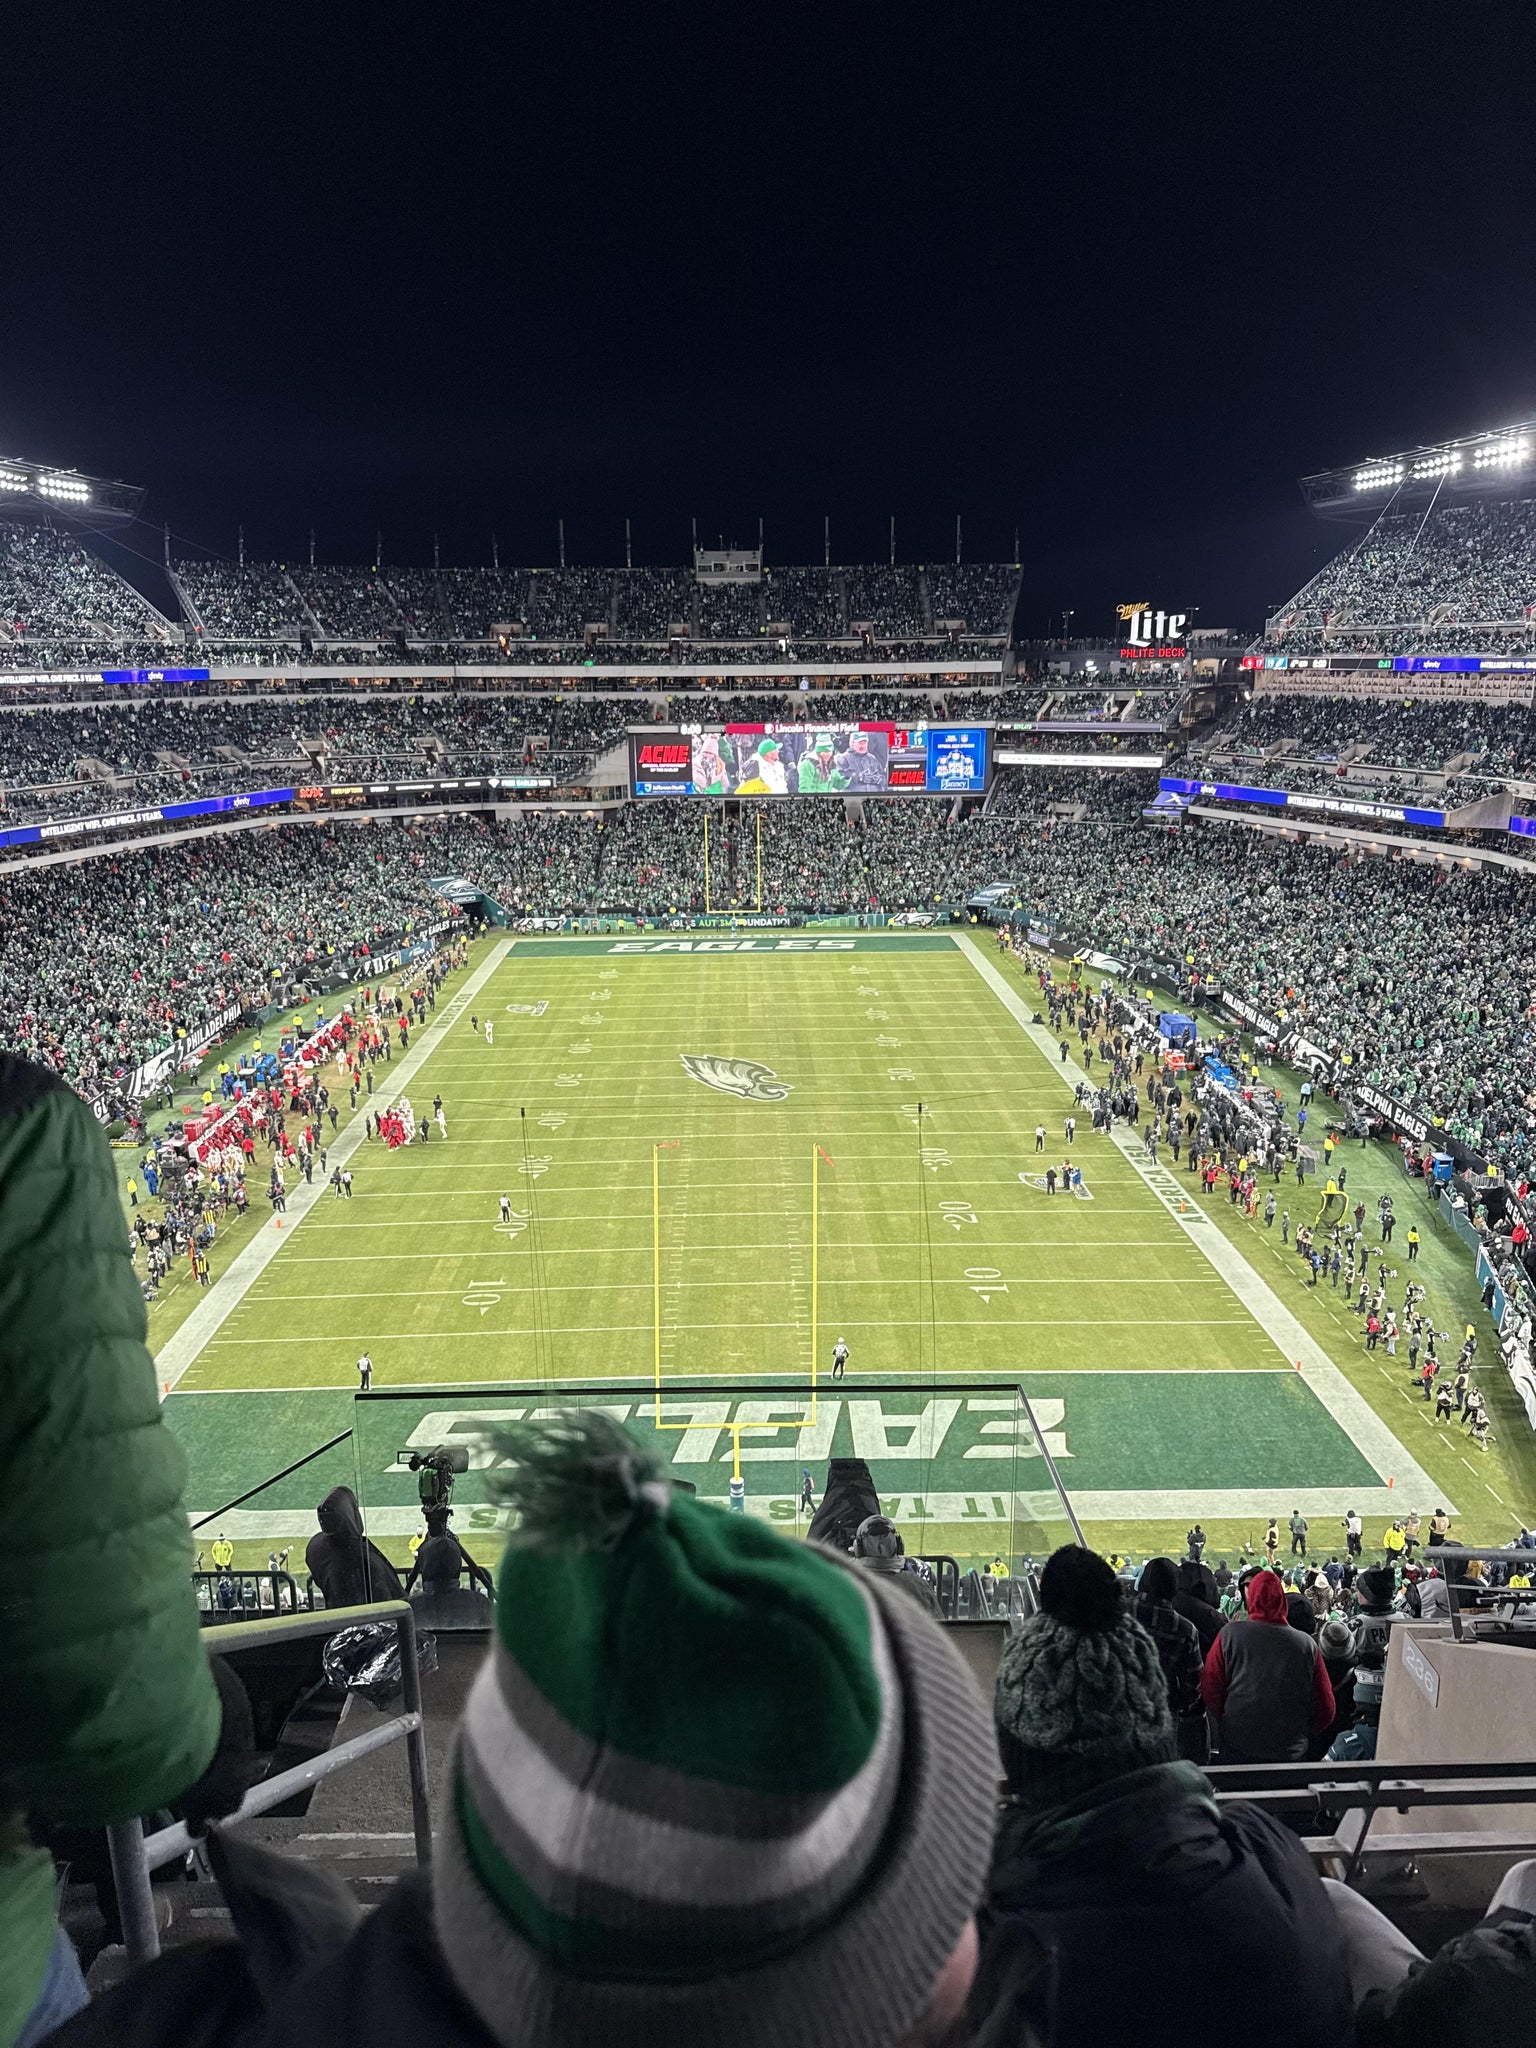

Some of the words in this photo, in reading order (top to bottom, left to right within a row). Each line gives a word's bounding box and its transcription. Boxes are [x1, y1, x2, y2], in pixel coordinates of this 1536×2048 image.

[1116, 602, 1150, 620] Miller
[1127, 611, 1186, 648] Lite
[1120, 648, 1154, 658] PHLITE
[1158, 648, 1185, 657] DECK
[775, 723, 804, 733] Lincoln
[804, 723, 839, 733] Financial
[840, 723, 859, 732] Field
[638, 745, 689, 763] ACME
[889, 771, 925, 784] ACME
[699, 919, 731, 927] AUTSM
[735, 918, 790, 927] FUNDATIO
[607, 939, 858, 953] EAGLES
[1222, 990, 1257, 1024] PHILADELPHIA
[1256, 1013, 1279, 1038] EAGLES
[187, 1002, 242, 1052] PHILADELPHIA
[1394, 1107, 1428, 1141] EAGLES
[1142, 1167, 1208, 1225] AMERICA
[938, 1200, 979, 1224] 20
[462, 1278, 506, 1306] 10
[963, 1267, 1010, 1294] 10
[961, 1496, 1006, 1518] IT
[1406, 1645, 1433, 1693] 236
